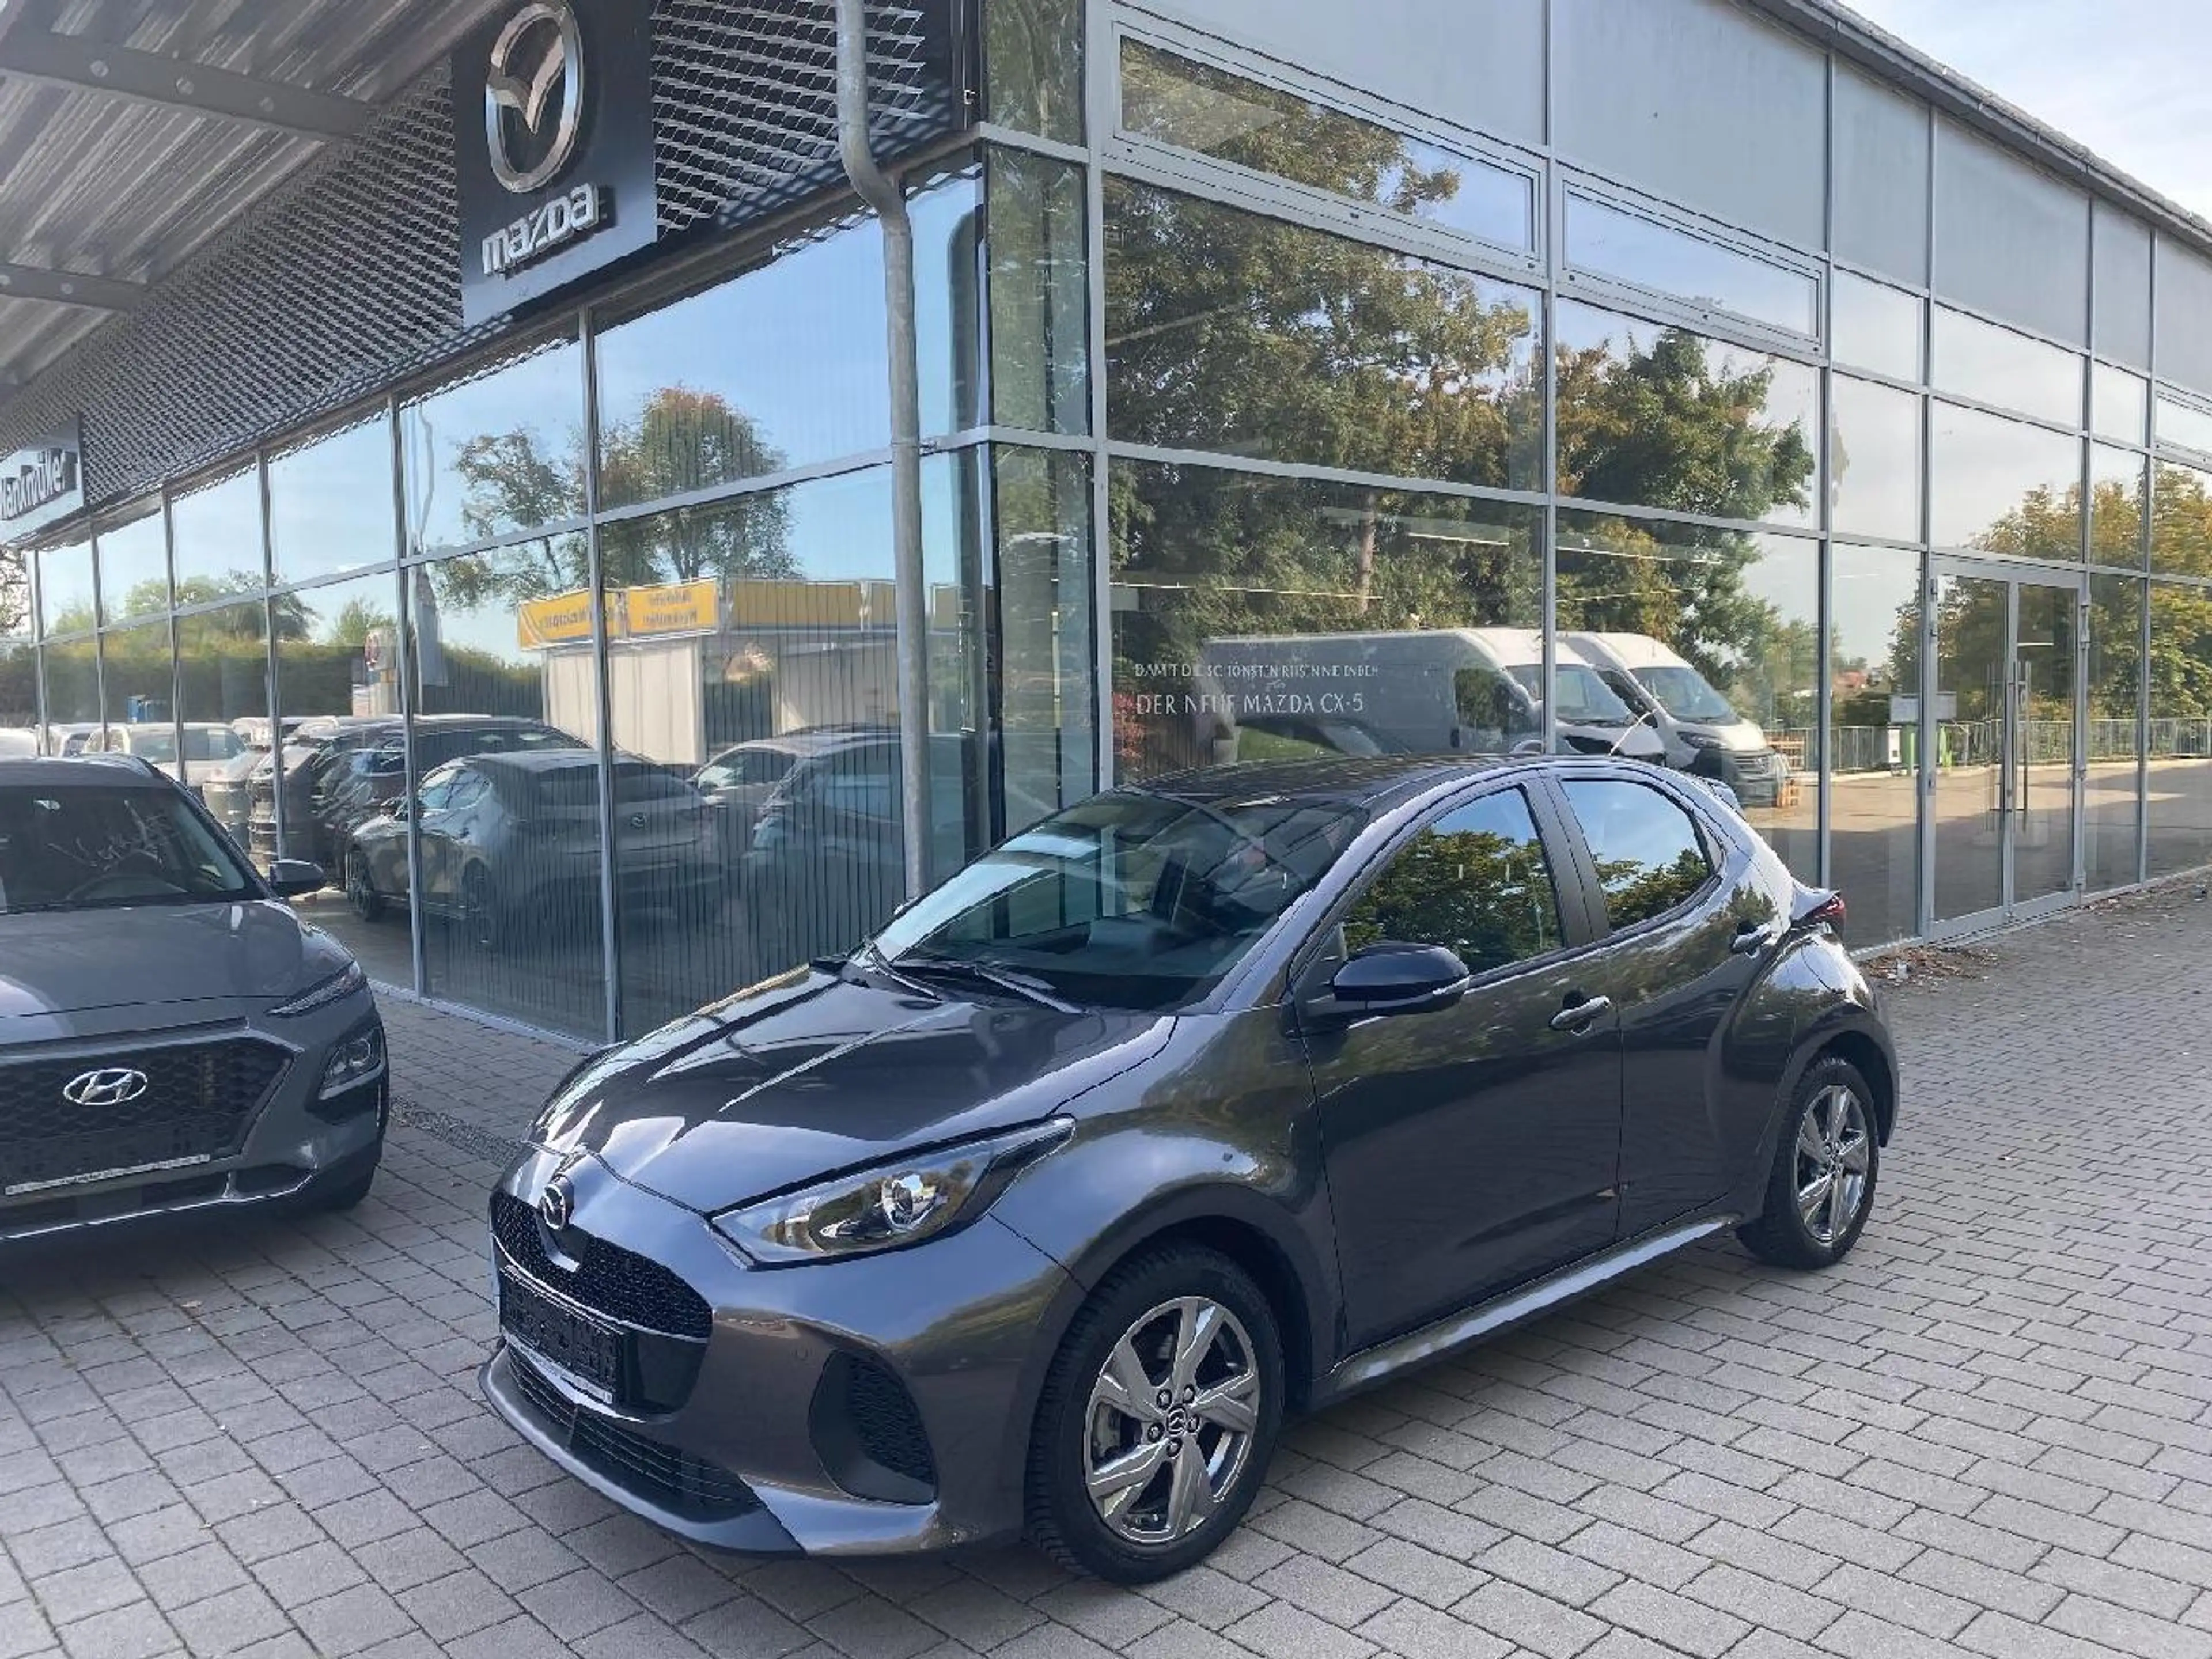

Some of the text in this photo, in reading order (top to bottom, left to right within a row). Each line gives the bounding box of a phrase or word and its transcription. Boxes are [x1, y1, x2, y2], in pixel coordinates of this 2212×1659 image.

[482, 183, 599, 276] mazda
[1137, 694, 1177, 715] DER
[1244, 693, 1315, 713] MAZDA
[1320, 692, 1363, 713] CX-5
